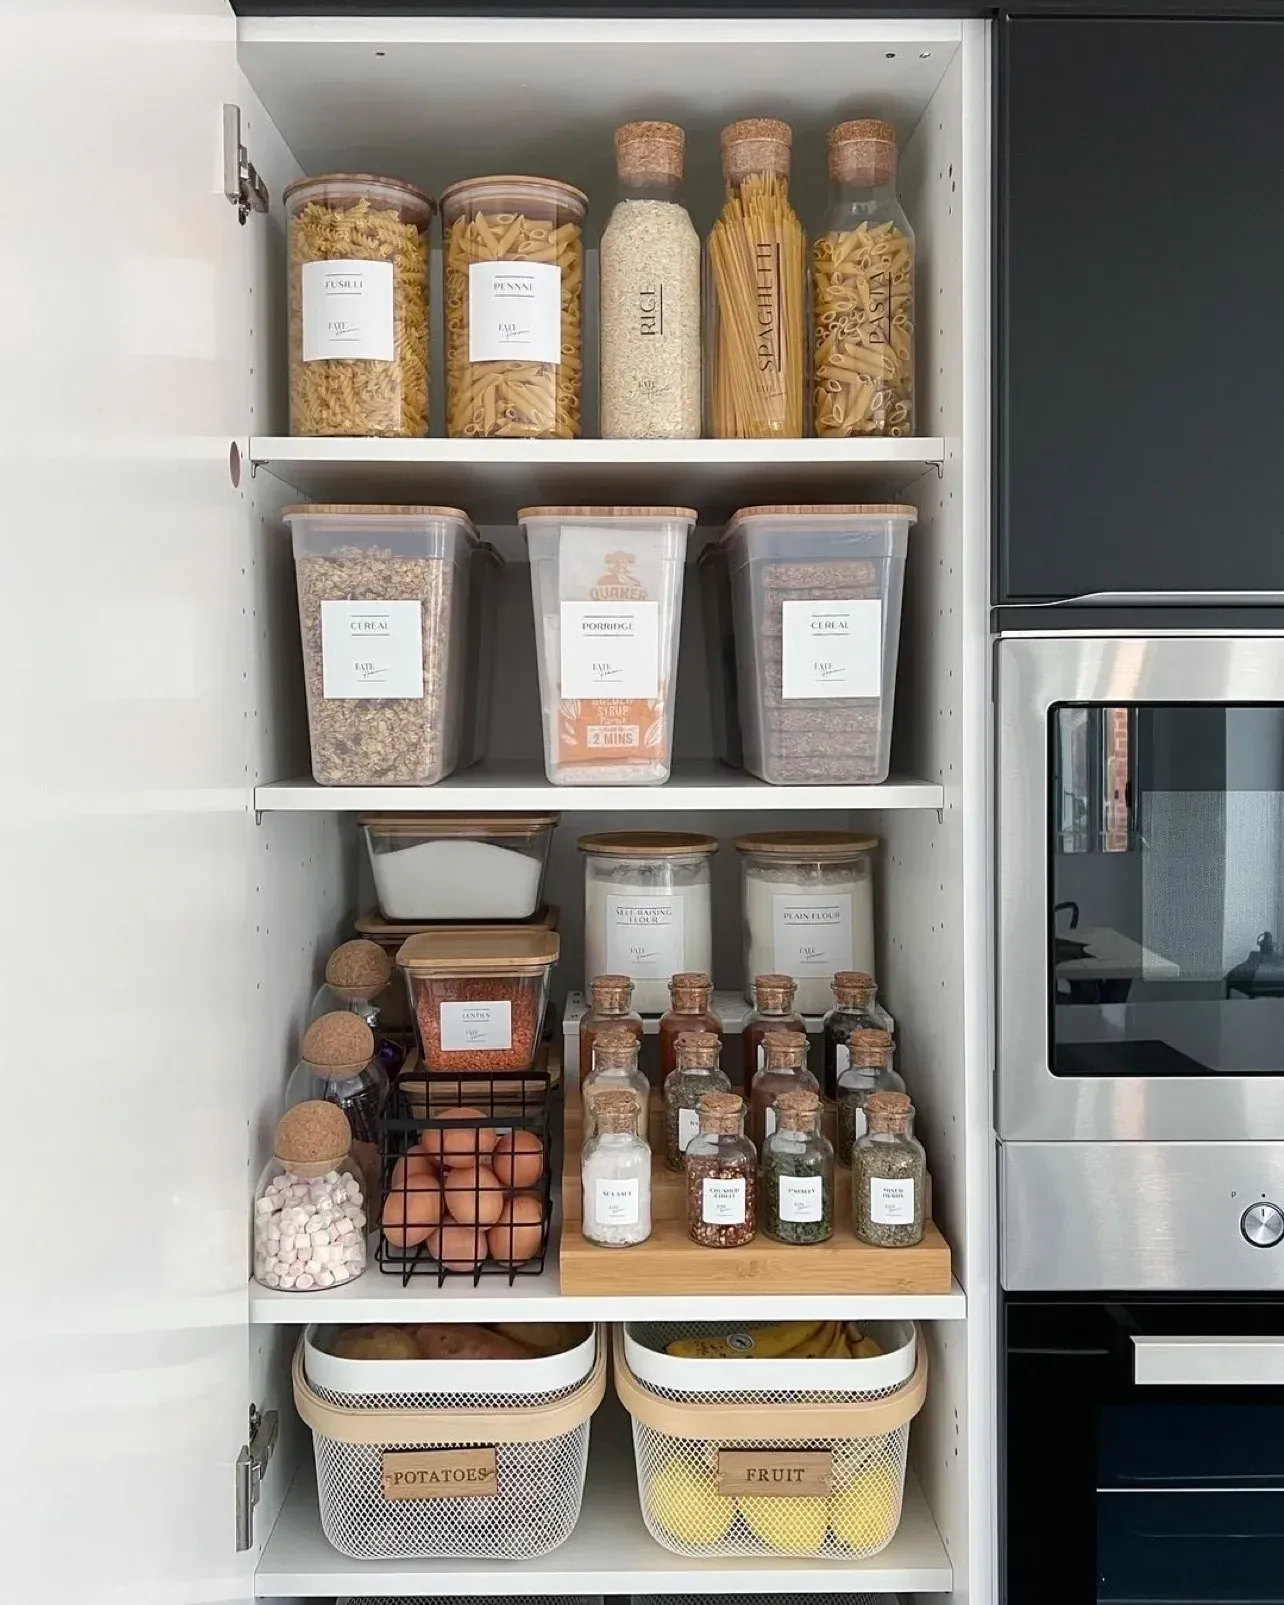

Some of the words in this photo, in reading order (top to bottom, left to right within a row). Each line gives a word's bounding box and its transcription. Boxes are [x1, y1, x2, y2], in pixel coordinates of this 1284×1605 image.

[325, 280, 363, 289] FUSILLI
[639, 284, 656, 336] RICE
[756, 243, 774, 372] SPAGHETTI
[868, 271, 885, 344] PASTA
[588, 586, 649, 601] QUAKER
[350, 621, 389, 630] CEREAL
[582, 622, 634, 631] PORRIDGE
[811, 620, 849, 630] CEREAL
[597, 705, 628, 717] SYRUP
[592, 732, 600, 745] 2
[604, 732, 633, 745] MINS
[784, 912, 809, 920] PLAIN
[811, 911, 841, 920] FLOUR
[393, 1467, 487, 1485] POTATOES
[746, 1468, 806, 1483] FRUIT
